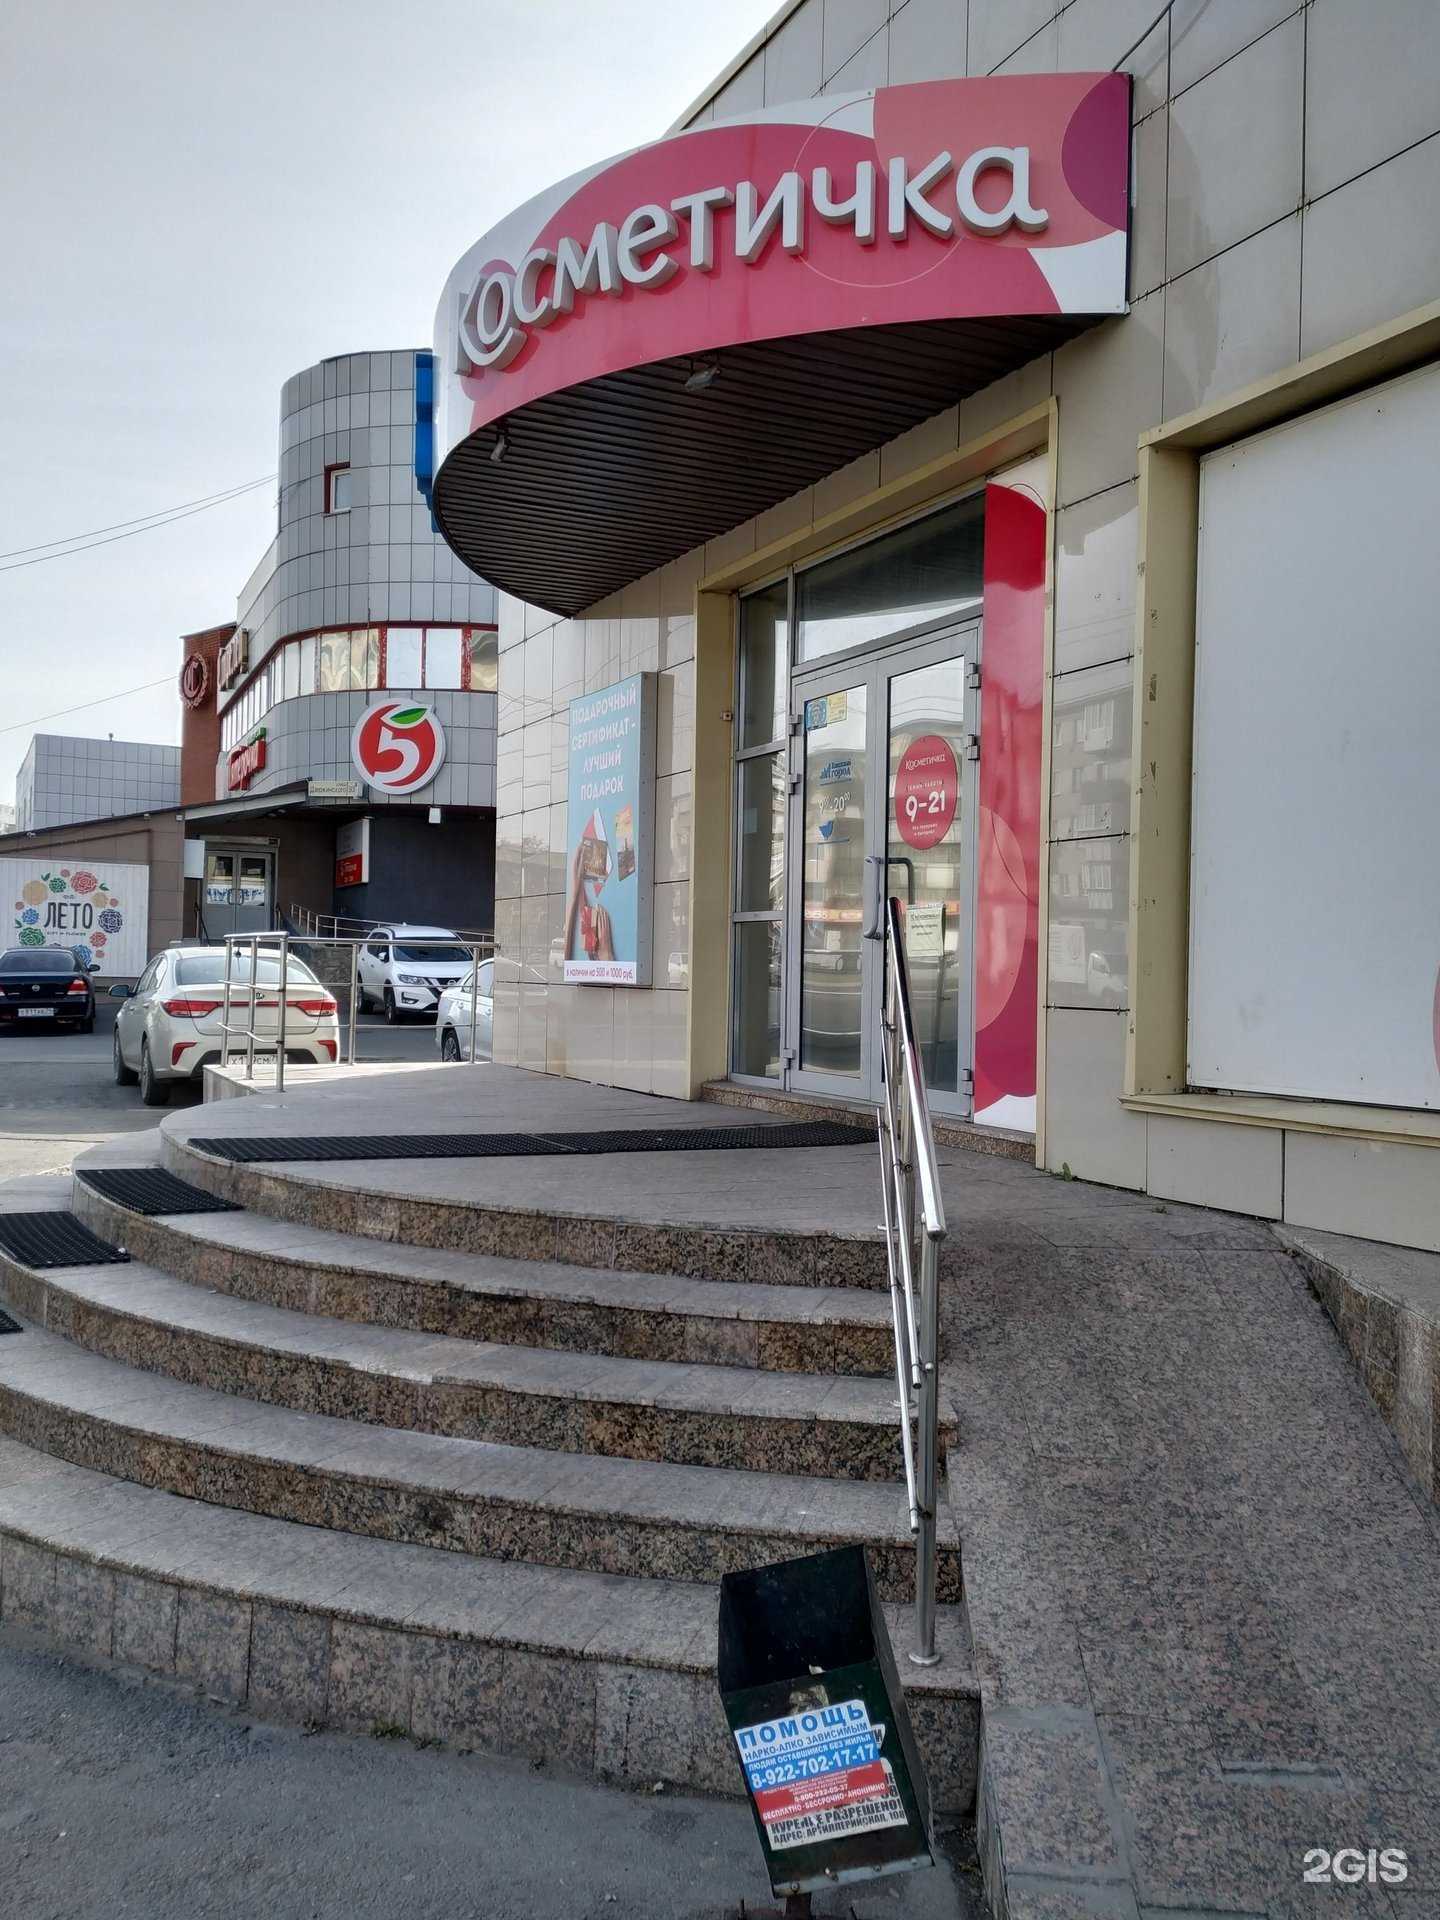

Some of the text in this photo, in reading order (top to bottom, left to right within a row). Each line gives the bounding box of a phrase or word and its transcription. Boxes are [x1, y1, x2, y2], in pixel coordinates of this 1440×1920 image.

[454, 145, 1049, 377] Косметичка
[573, 684, 636, 724] ПОДАРОЧНЫЙ
[374, 720, 422, 784] 5
[584, 745, 622, 774] ЛУЧШИЙ
[581, 776, 624, 802] ПОДАРОК
[905, 790, 945, 823] 9-21
[44, 902, 93, 929] ЛЕТО
[738, 1704, 864, 1749] ПОМОЩЬ
[806, 1722, 868, 1745] ЗАВИСИМЫМ
[749, 1758, 778, 1770] ЛЮДЯМ
[777, 1744, 830, 1763] ОСТАВШИМСЯ
[751, 1743, 875, 1788] 8-922-702-17-17
